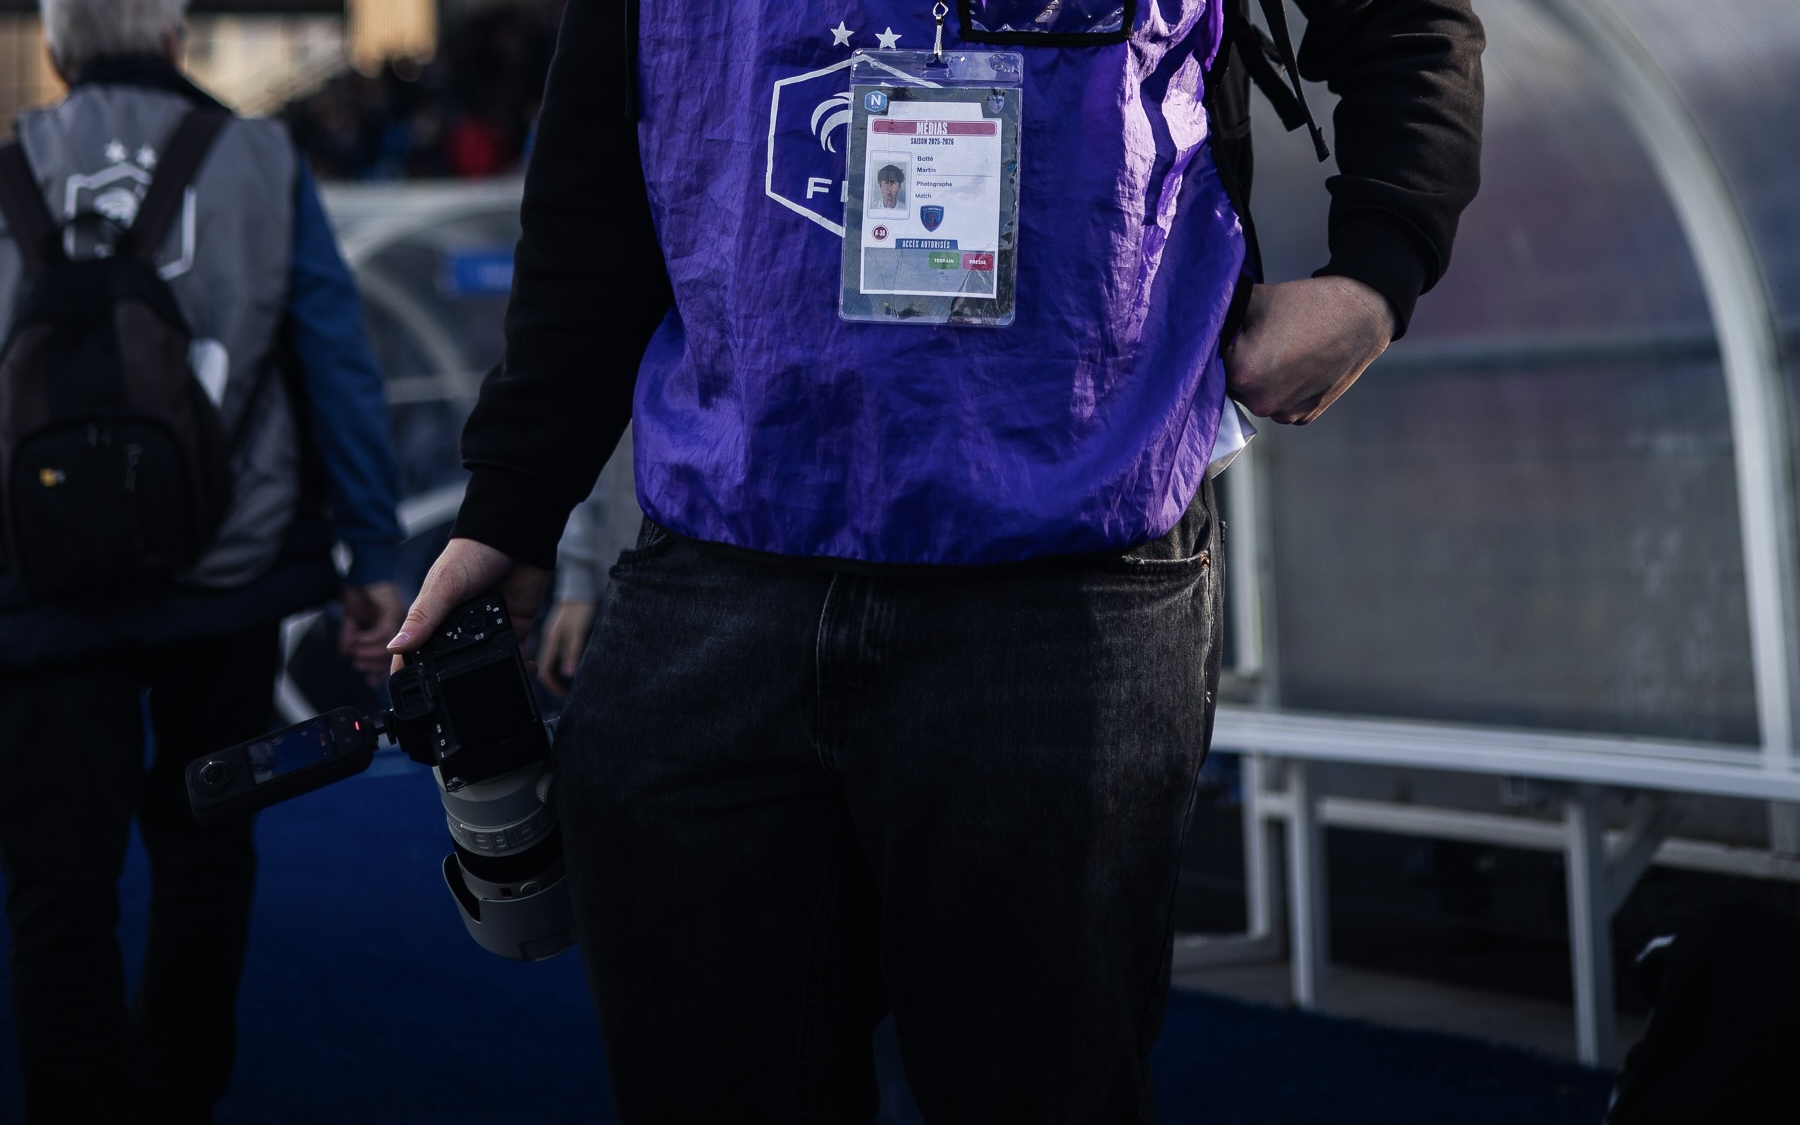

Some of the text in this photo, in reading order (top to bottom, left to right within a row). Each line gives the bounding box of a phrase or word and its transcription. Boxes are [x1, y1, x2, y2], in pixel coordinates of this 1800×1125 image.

[871, 95, 881, 105] N
[916, 120, 948, 134] MÉDIAS
[920, 240, 951, 249] AUTORISÉS
